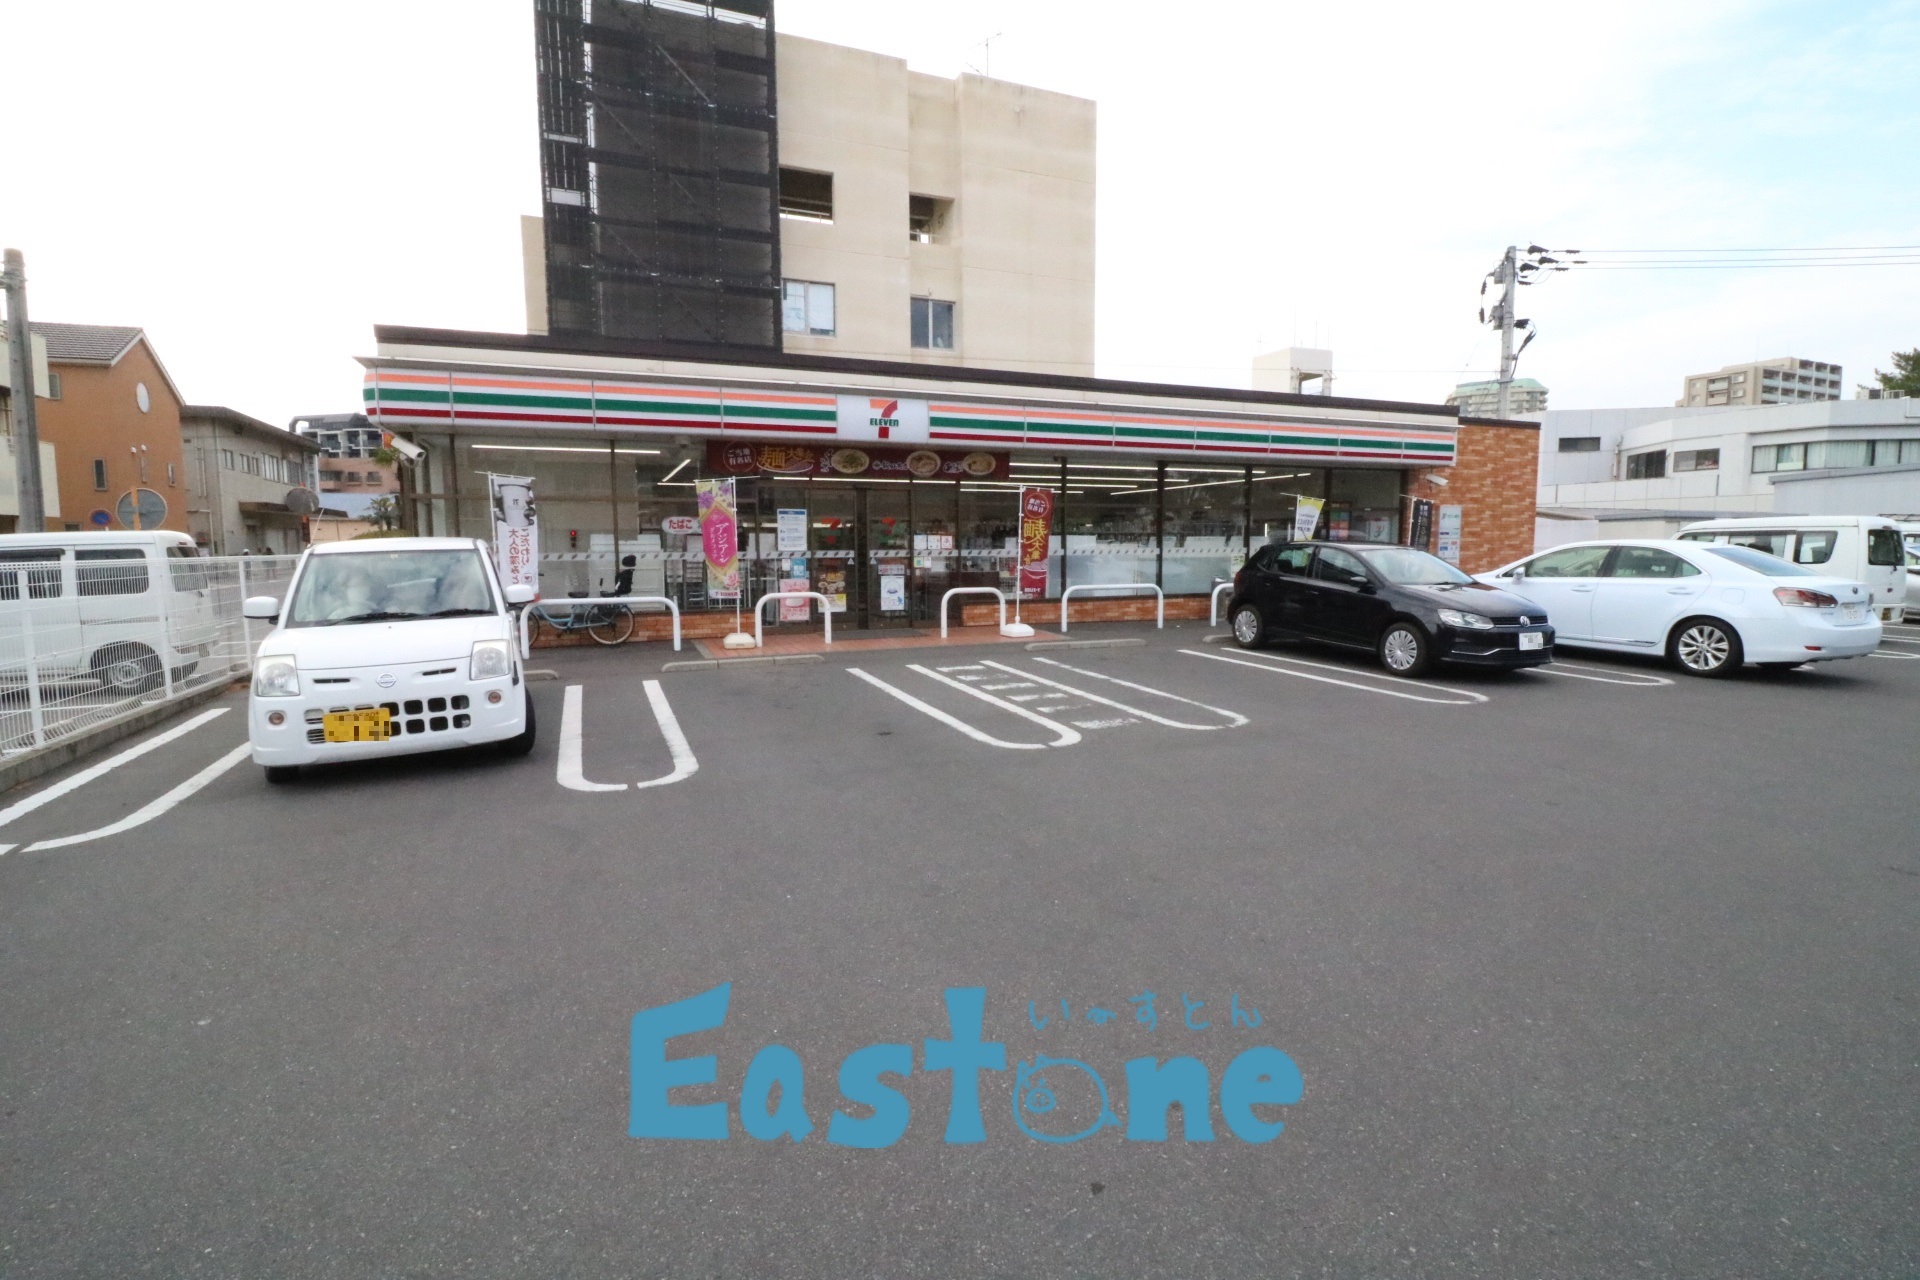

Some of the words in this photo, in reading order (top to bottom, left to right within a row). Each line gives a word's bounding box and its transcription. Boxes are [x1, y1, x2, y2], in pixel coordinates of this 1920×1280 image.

[869, 399, 898, 439] 7
[668, 519, 693, 530] たばこ
[716, 522, 729, 563] アジアン
